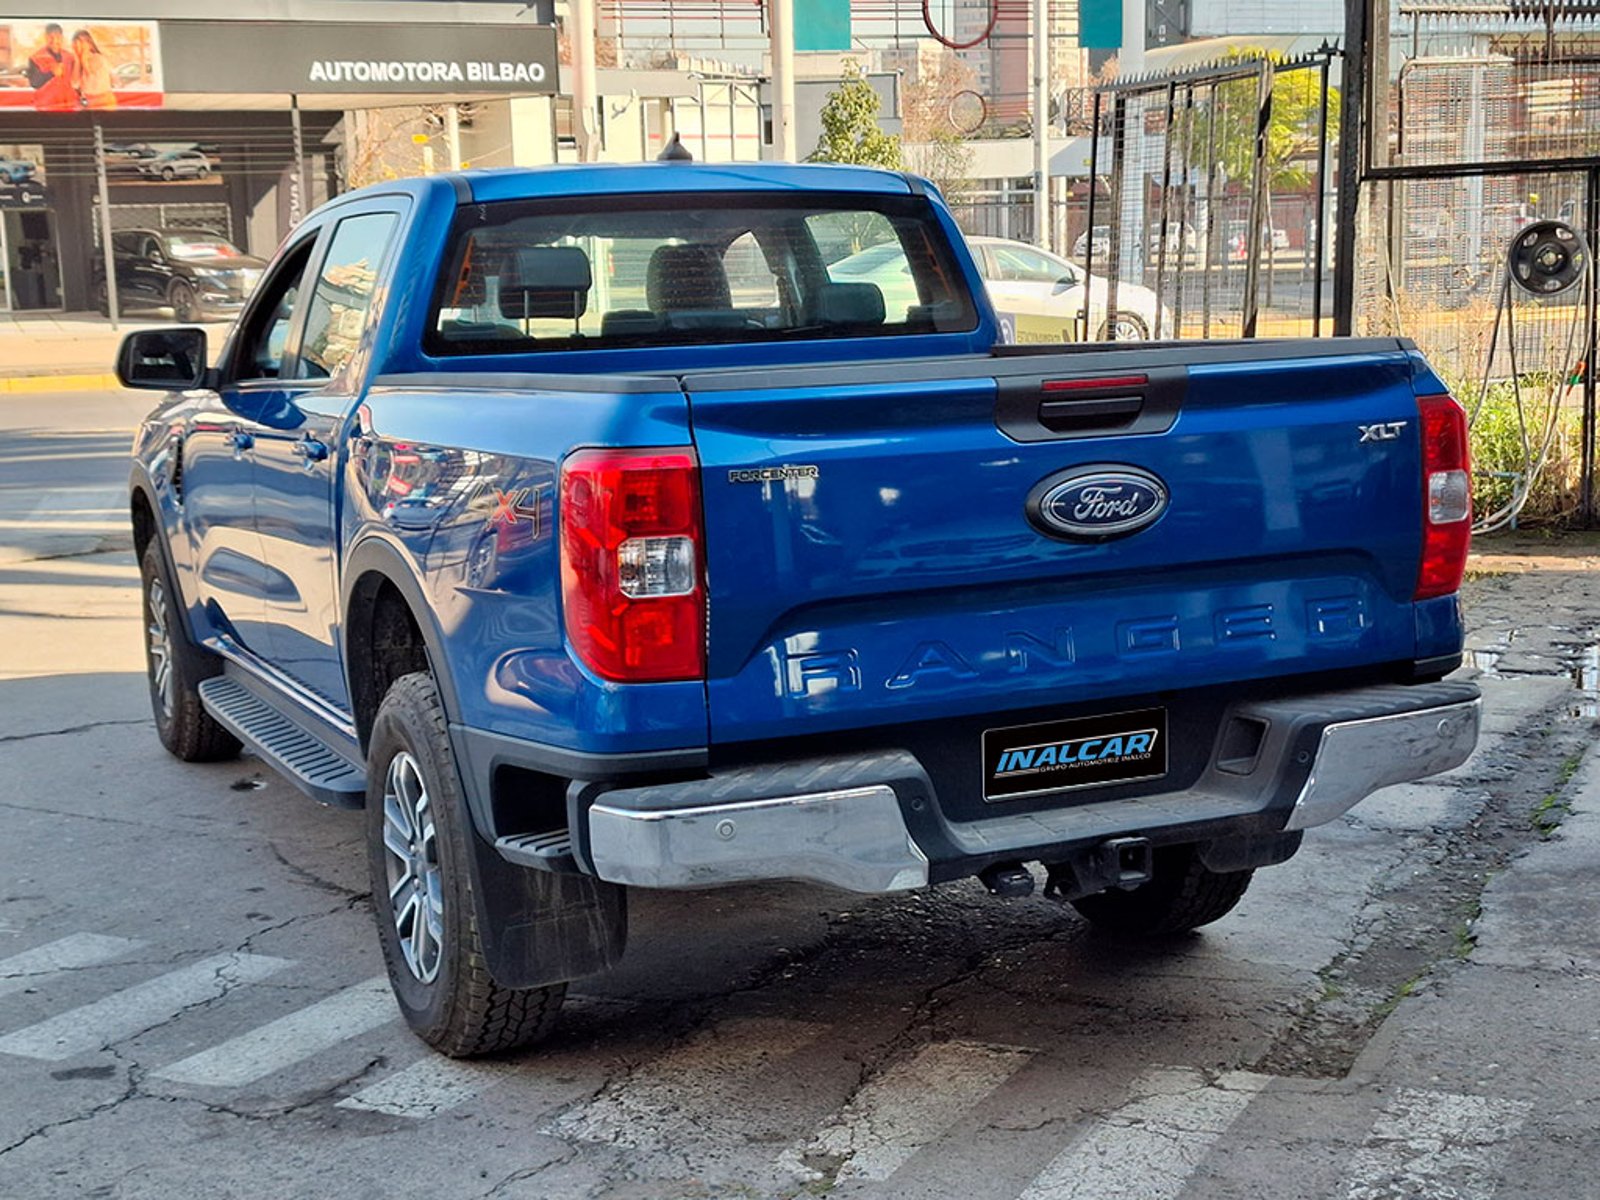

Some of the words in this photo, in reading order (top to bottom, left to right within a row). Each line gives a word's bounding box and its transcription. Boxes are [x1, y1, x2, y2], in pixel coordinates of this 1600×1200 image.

[309, 61, 464, 82] AUTOMOTORA
[466, 62, 545, 82] BILBAO
[1358, 420, 1408, 442] XLT
[728, 464, 820, 483] FORCENTER
[1074, 486, 1139, 520] Ford
[781, 598, 1367, 696] RANGER
[996, 734, 1151, 772] INALCAR
[1040, 763, 1068, 773] GRUPO
[1068, 757, 1120, 769] AUTOMOTRIZ
[1121, 752, 1152, 762] INALCO
